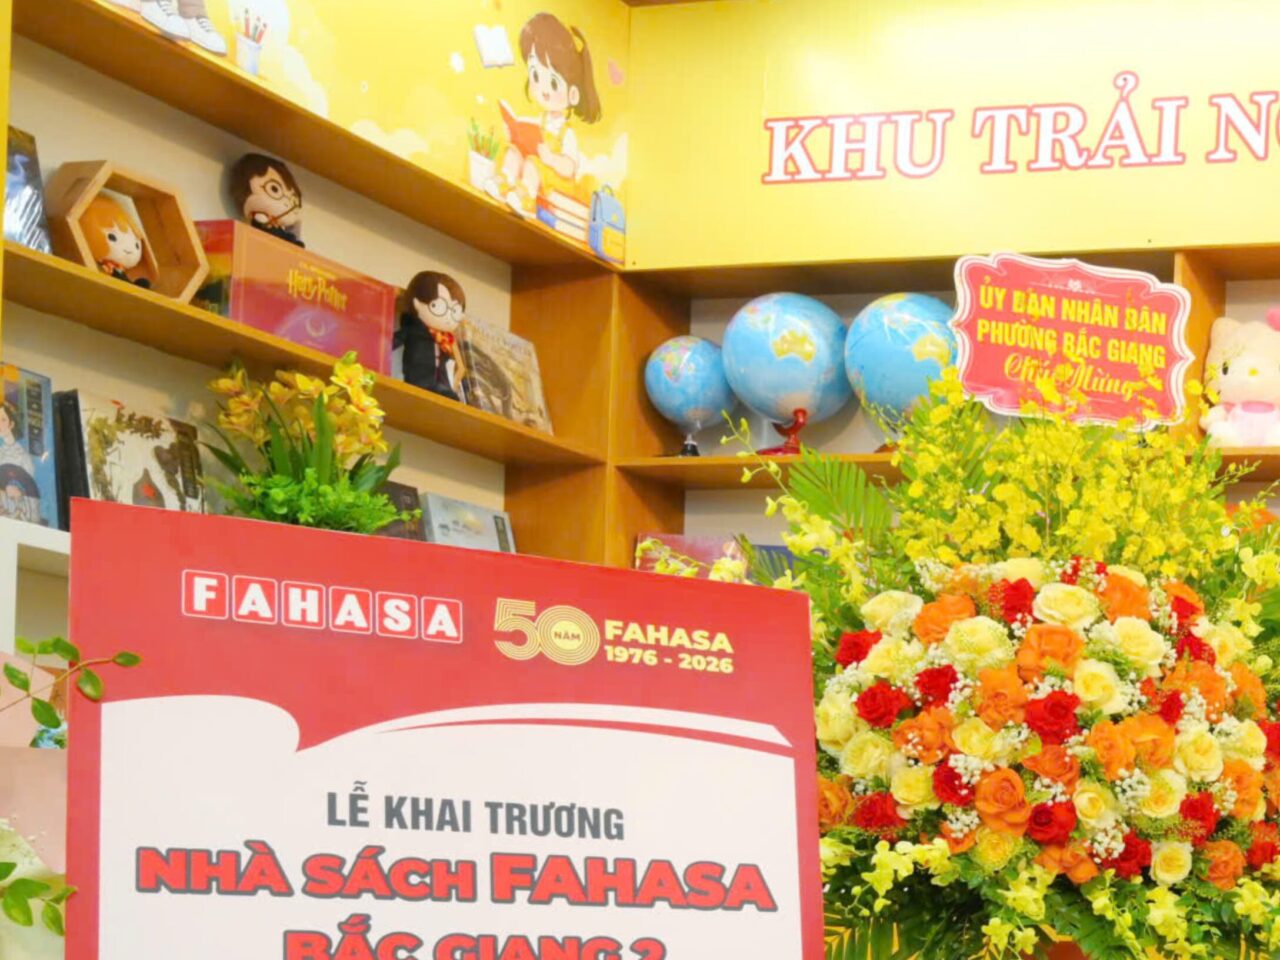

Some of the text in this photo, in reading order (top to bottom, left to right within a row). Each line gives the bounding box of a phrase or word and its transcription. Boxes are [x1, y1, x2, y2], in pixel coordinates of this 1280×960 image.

[761, 109, 954, 185] KHU
[972, 70, 1189, 175] TRẢI
[979, 275, 1006, 311] ỦY
[1061, 298, 1119, 328] NHÂN
[977, 319, 1167, 368] PHƯỜNG BẮC GIANG
[1004, 352, 1069, 384] Chú
[189, 574, 462, 641] FAHASA
[493, 596, 601, 667] 50
[551, 626, 582, 643] NĂM
[604, 618, 734, 654] FAHASA
[604, 644, 658, 666] 1976
[678, 651, 734, 674] 2026
[326, 779, 625, 842] LỄ KHAI TRƯƠNG
[135, 839, 779, 913] NHÀ SÁCH FAHASA
